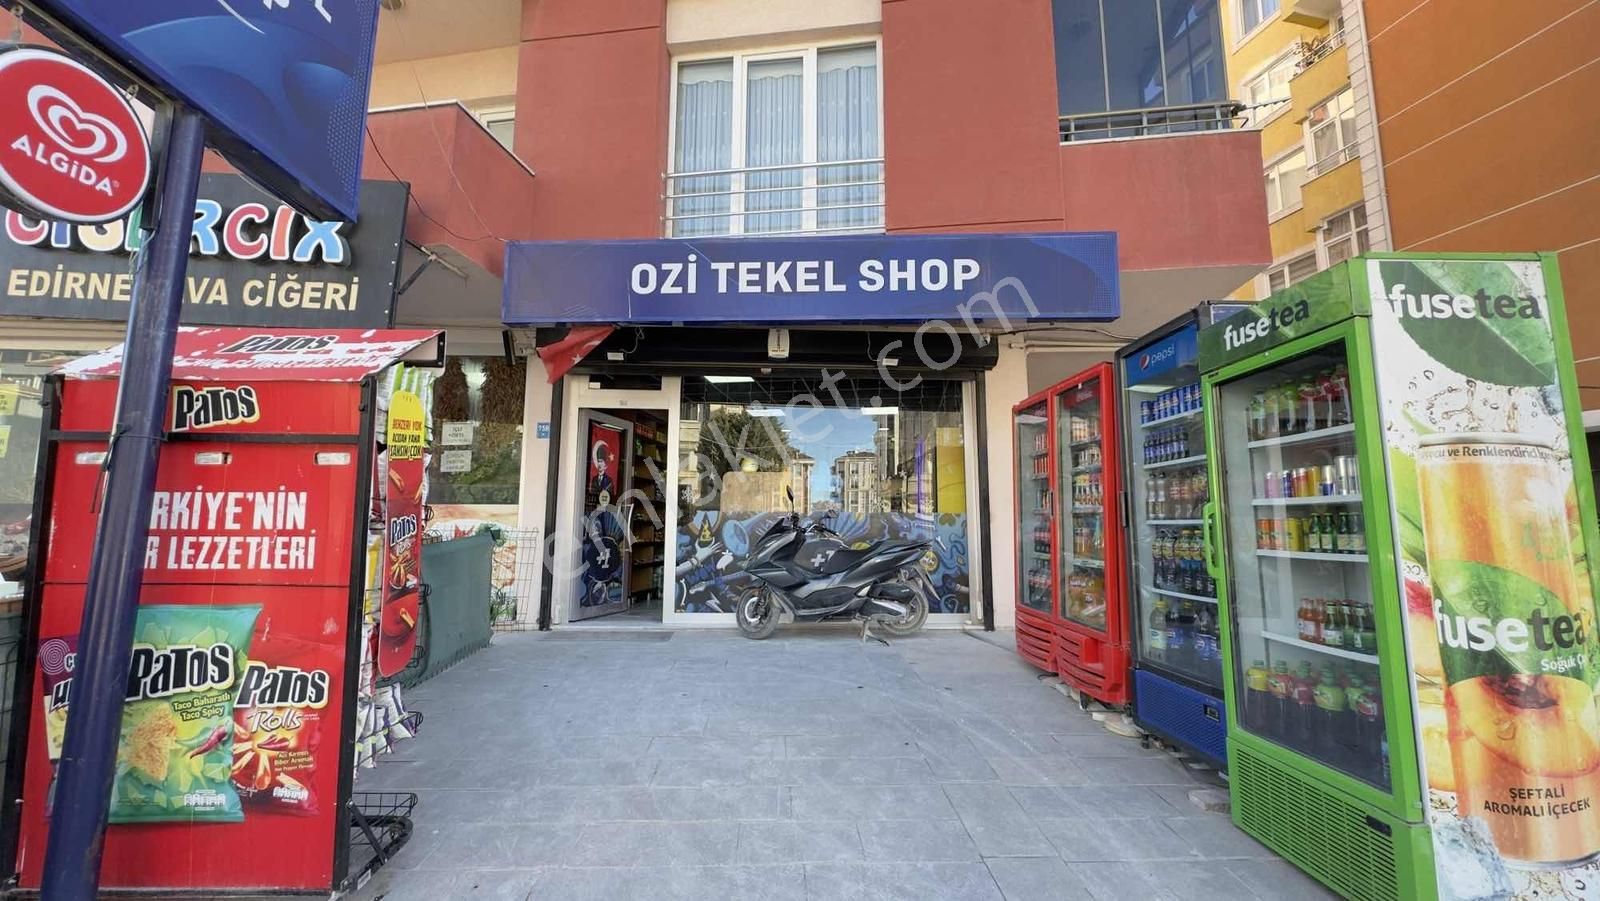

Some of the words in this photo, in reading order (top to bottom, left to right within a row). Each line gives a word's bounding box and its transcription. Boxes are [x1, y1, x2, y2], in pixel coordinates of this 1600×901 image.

[631, 254, 697, 294] OZİ
[711, 260, 846, 293] TEKEL
[858, 259, 980, 291] SHOP
[7, 264, 132, 301] EDİRNE
[242, 273, 360, 311] CİĞERİ
[1151, 344, 1175, 366] pepsi
[1447, 449, 1460, 457] ve
[150, 485, 307, 529] RKİYE'NİN
[167, 529, 316, 569] LEZZETLERİ
[1541, 655, 1576, 673] Soğuk
[174, 701, 192, 711] Taco
[181, 711, 200, 721] Taco
[201, 706, 225, 718] Spicy
[247, 708, 302, 733] Rolls
[1509, 784, 1565, 802] ŞEFTALİ
[1484, 800, 1544, 817] AROMALI
[1547, 797, 1591, 819] İÇECEK
